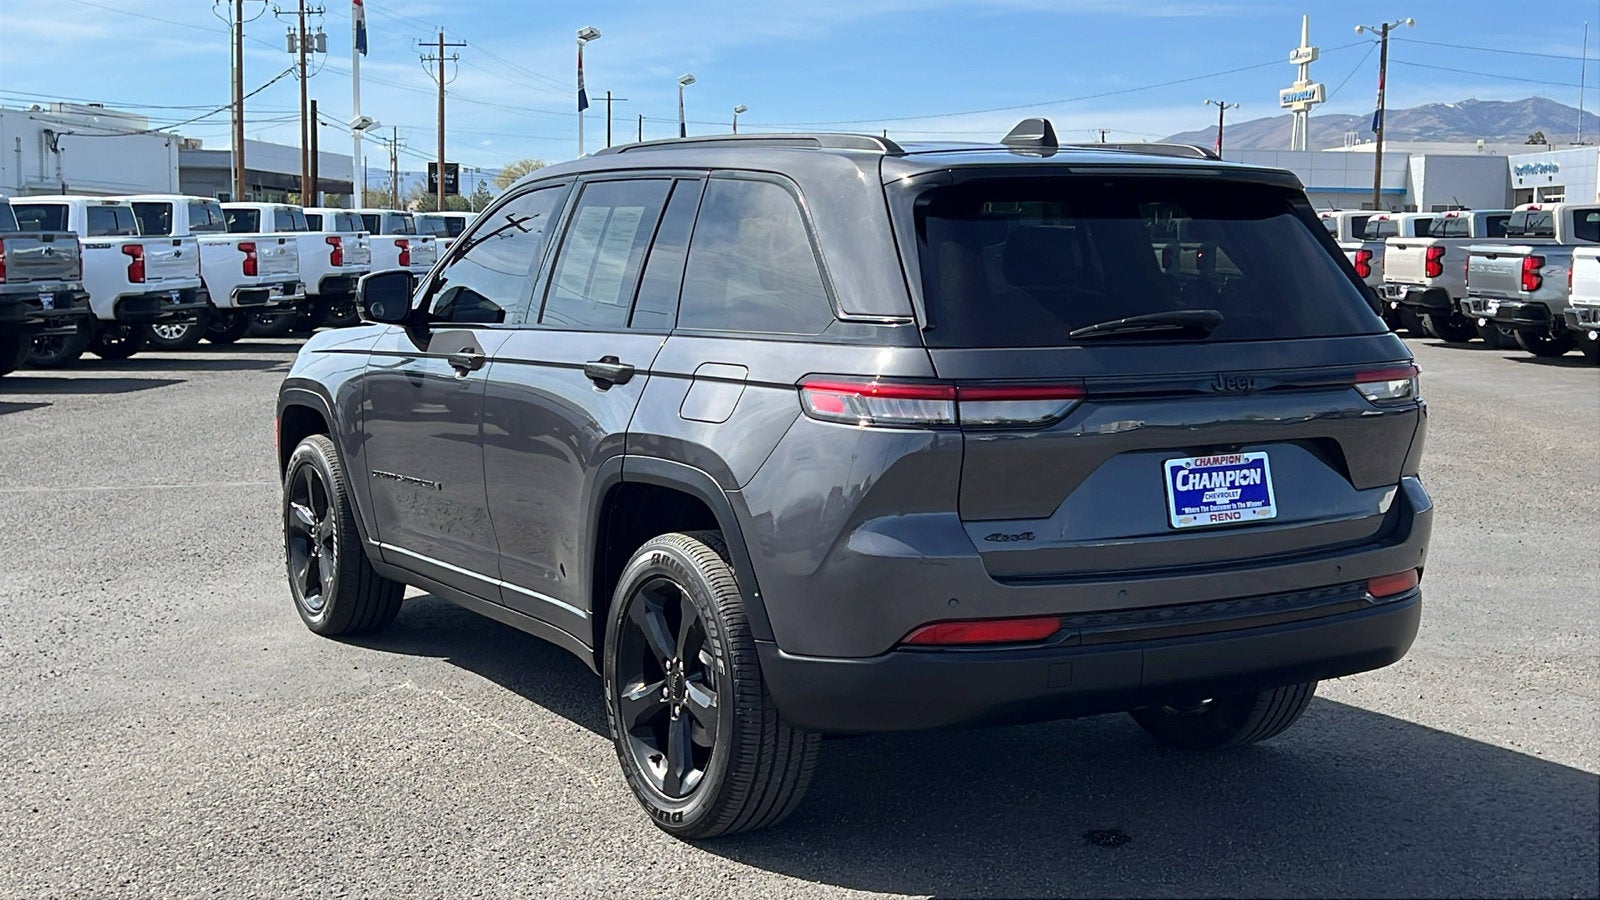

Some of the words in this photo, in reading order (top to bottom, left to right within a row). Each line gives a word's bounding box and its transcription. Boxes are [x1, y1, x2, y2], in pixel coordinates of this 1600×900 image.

[1211, 371, 1255, 395] Jeep
[1194, 455, 1241, 467] CHAMPION
[1204, 490, 1239, 500] CHEVROLET
[1209, 511, 1241, 523] RENO
